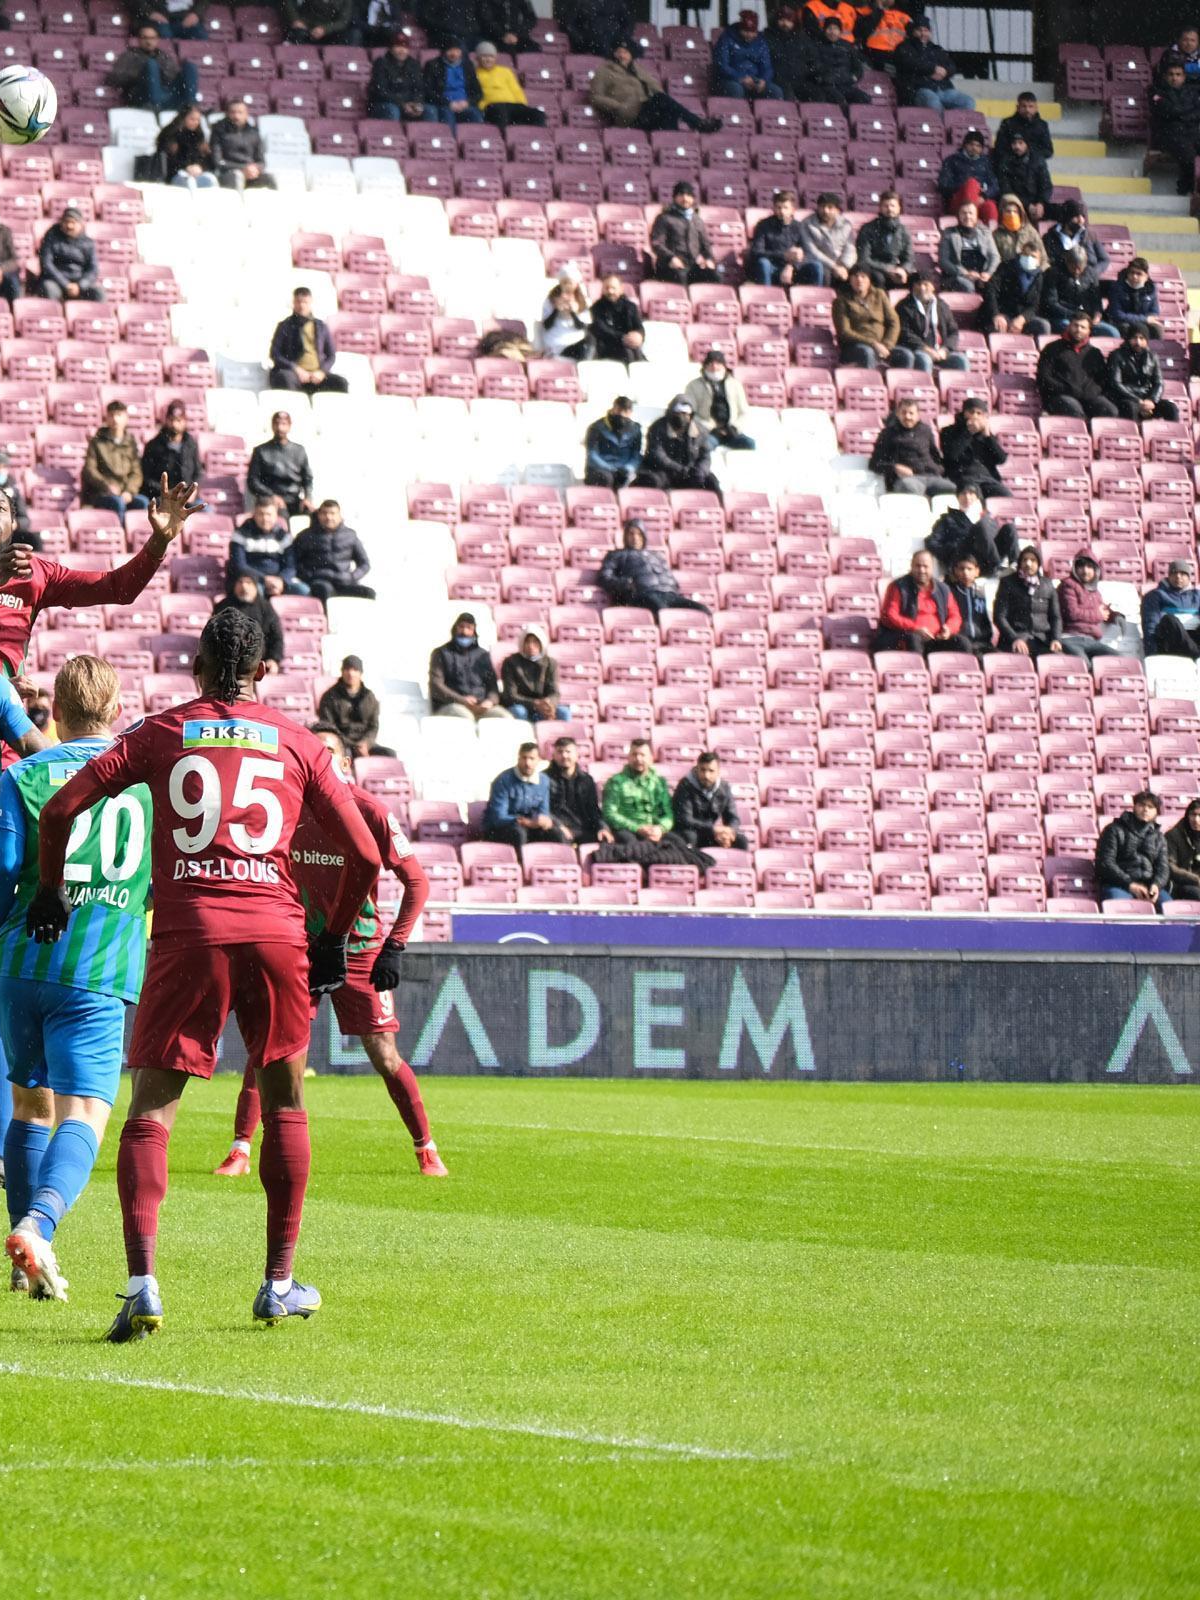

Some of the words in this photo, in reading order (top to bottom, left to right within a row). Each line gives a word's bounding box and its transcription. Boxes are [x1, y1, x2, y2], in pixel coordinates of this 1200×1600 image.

[200, 725, 262, 743] aksa
[168, 755, 285, 855] 95
[63, 793, 145, 882] 20
[378, 989, 395, 1016] 9
